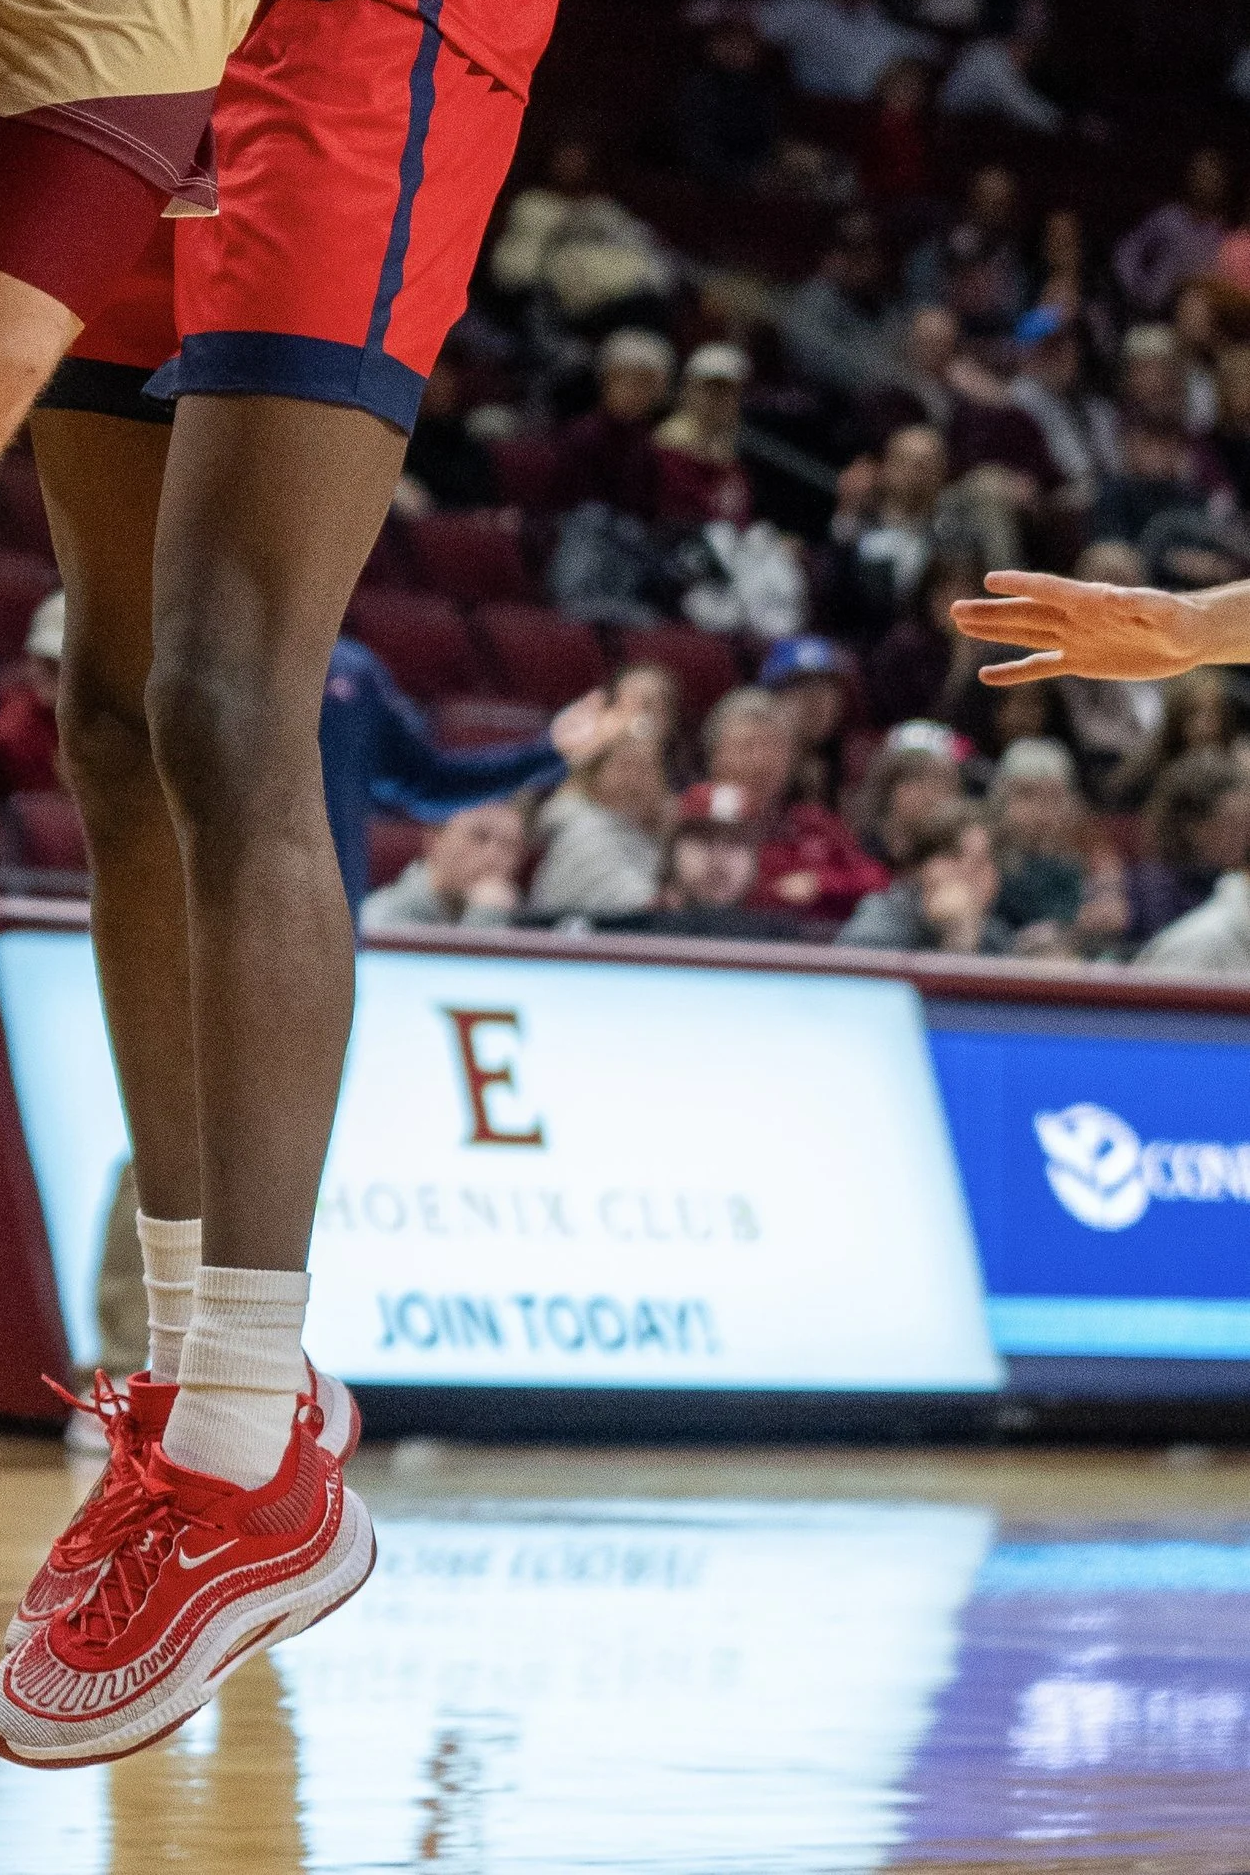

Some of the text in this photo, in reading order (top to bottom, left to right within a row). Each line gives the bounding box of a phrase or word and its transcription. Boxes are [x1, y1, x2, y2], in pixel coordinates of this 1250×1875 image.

[444, 1008, 545, 1146] E
[599, 1188, 762, 1243] CLUB
[377, 1292, 502, 1353] JOIN
